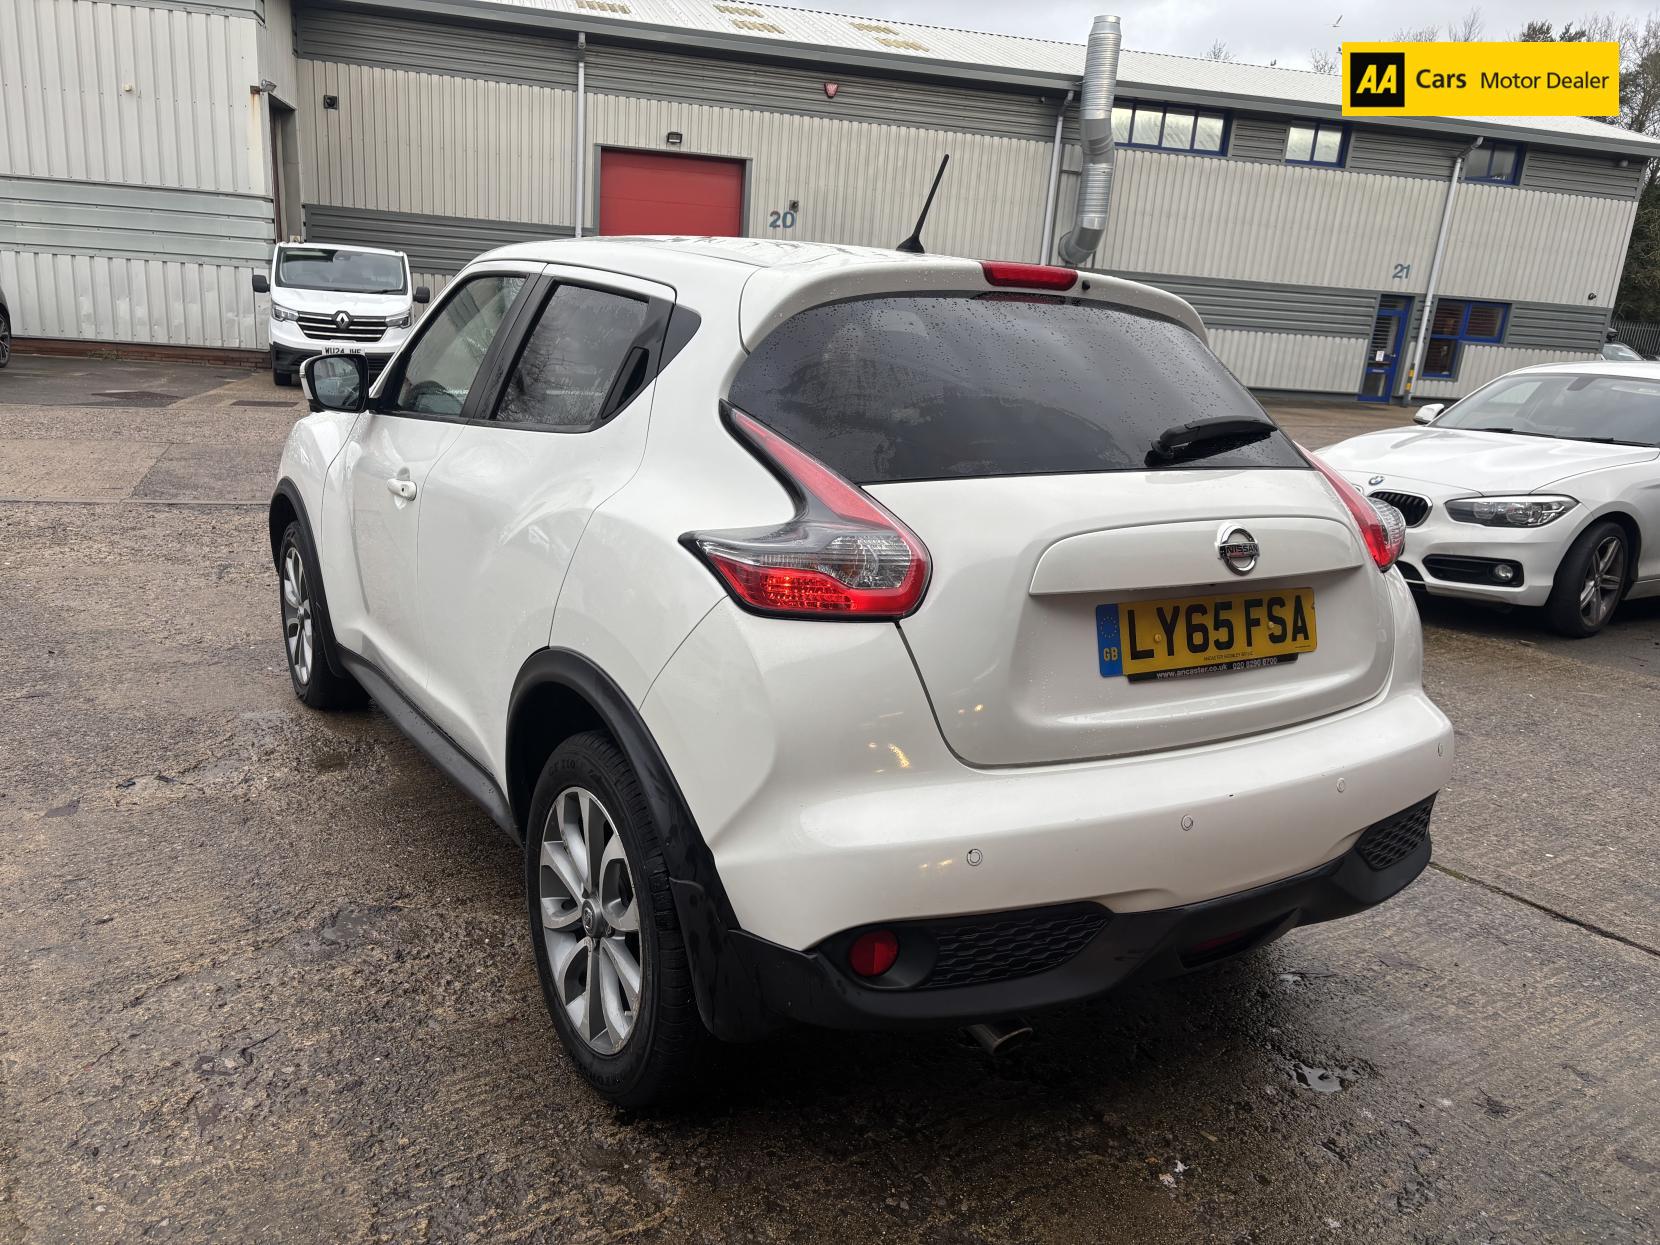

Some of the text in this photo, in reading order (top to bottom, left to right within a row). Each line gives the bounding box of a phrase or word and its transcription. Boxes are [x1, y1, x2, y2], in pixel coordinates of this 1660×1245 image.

[769, 210, 795, 229] 20
[1392, 263, 1411, 279] 21
[1226, 543, 1258, 553] NISSAN
[1127, 595, 1310, 661] LY65 FSA
[1103, 647, 1119, 661] GB
[1156, 664, 1228, 679] www.ancaster.co.uk
